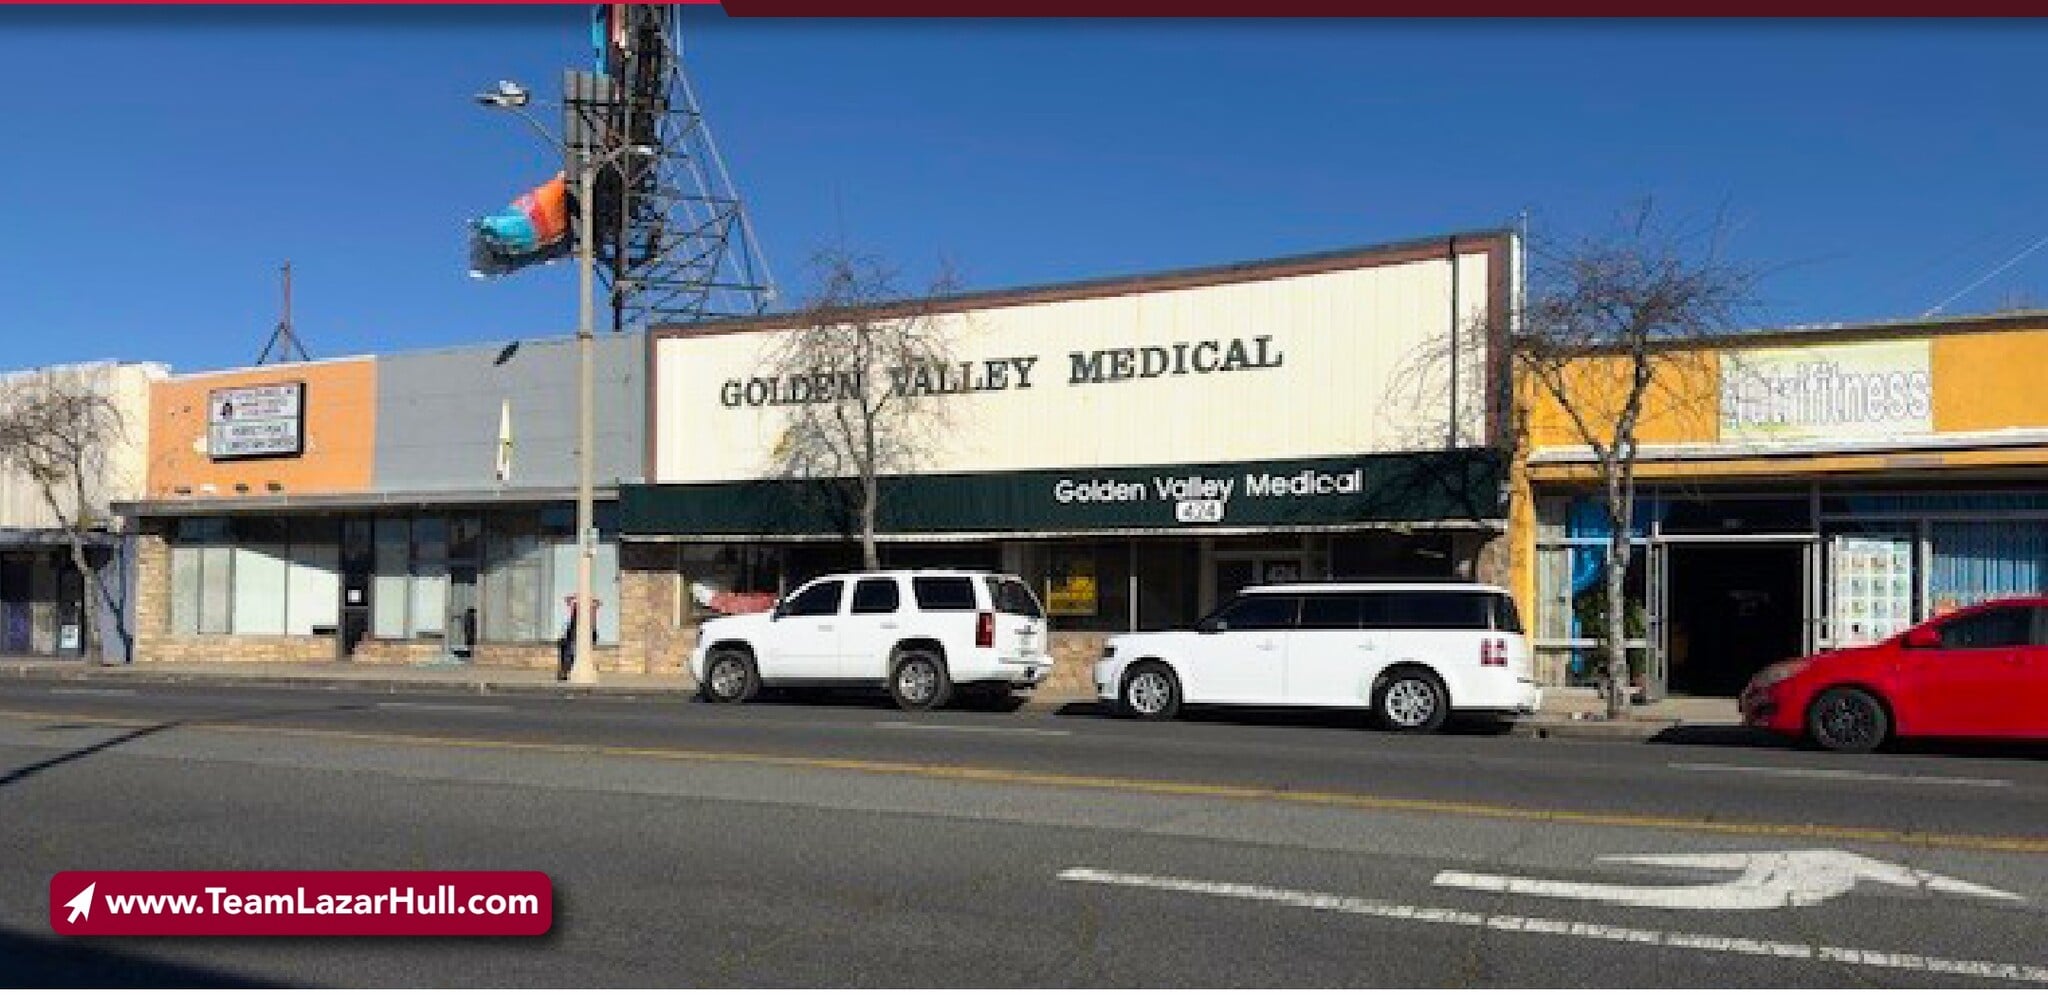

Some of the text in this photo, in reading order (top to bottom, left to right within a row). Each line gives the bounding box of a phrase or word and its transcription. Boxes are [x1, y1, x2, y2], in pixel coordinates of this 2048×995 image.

[719, 334, 1284, 408] GOLDEN VALLEY MEDICAL
[1053, 468, 1364, 504] Golden Valley Medical
